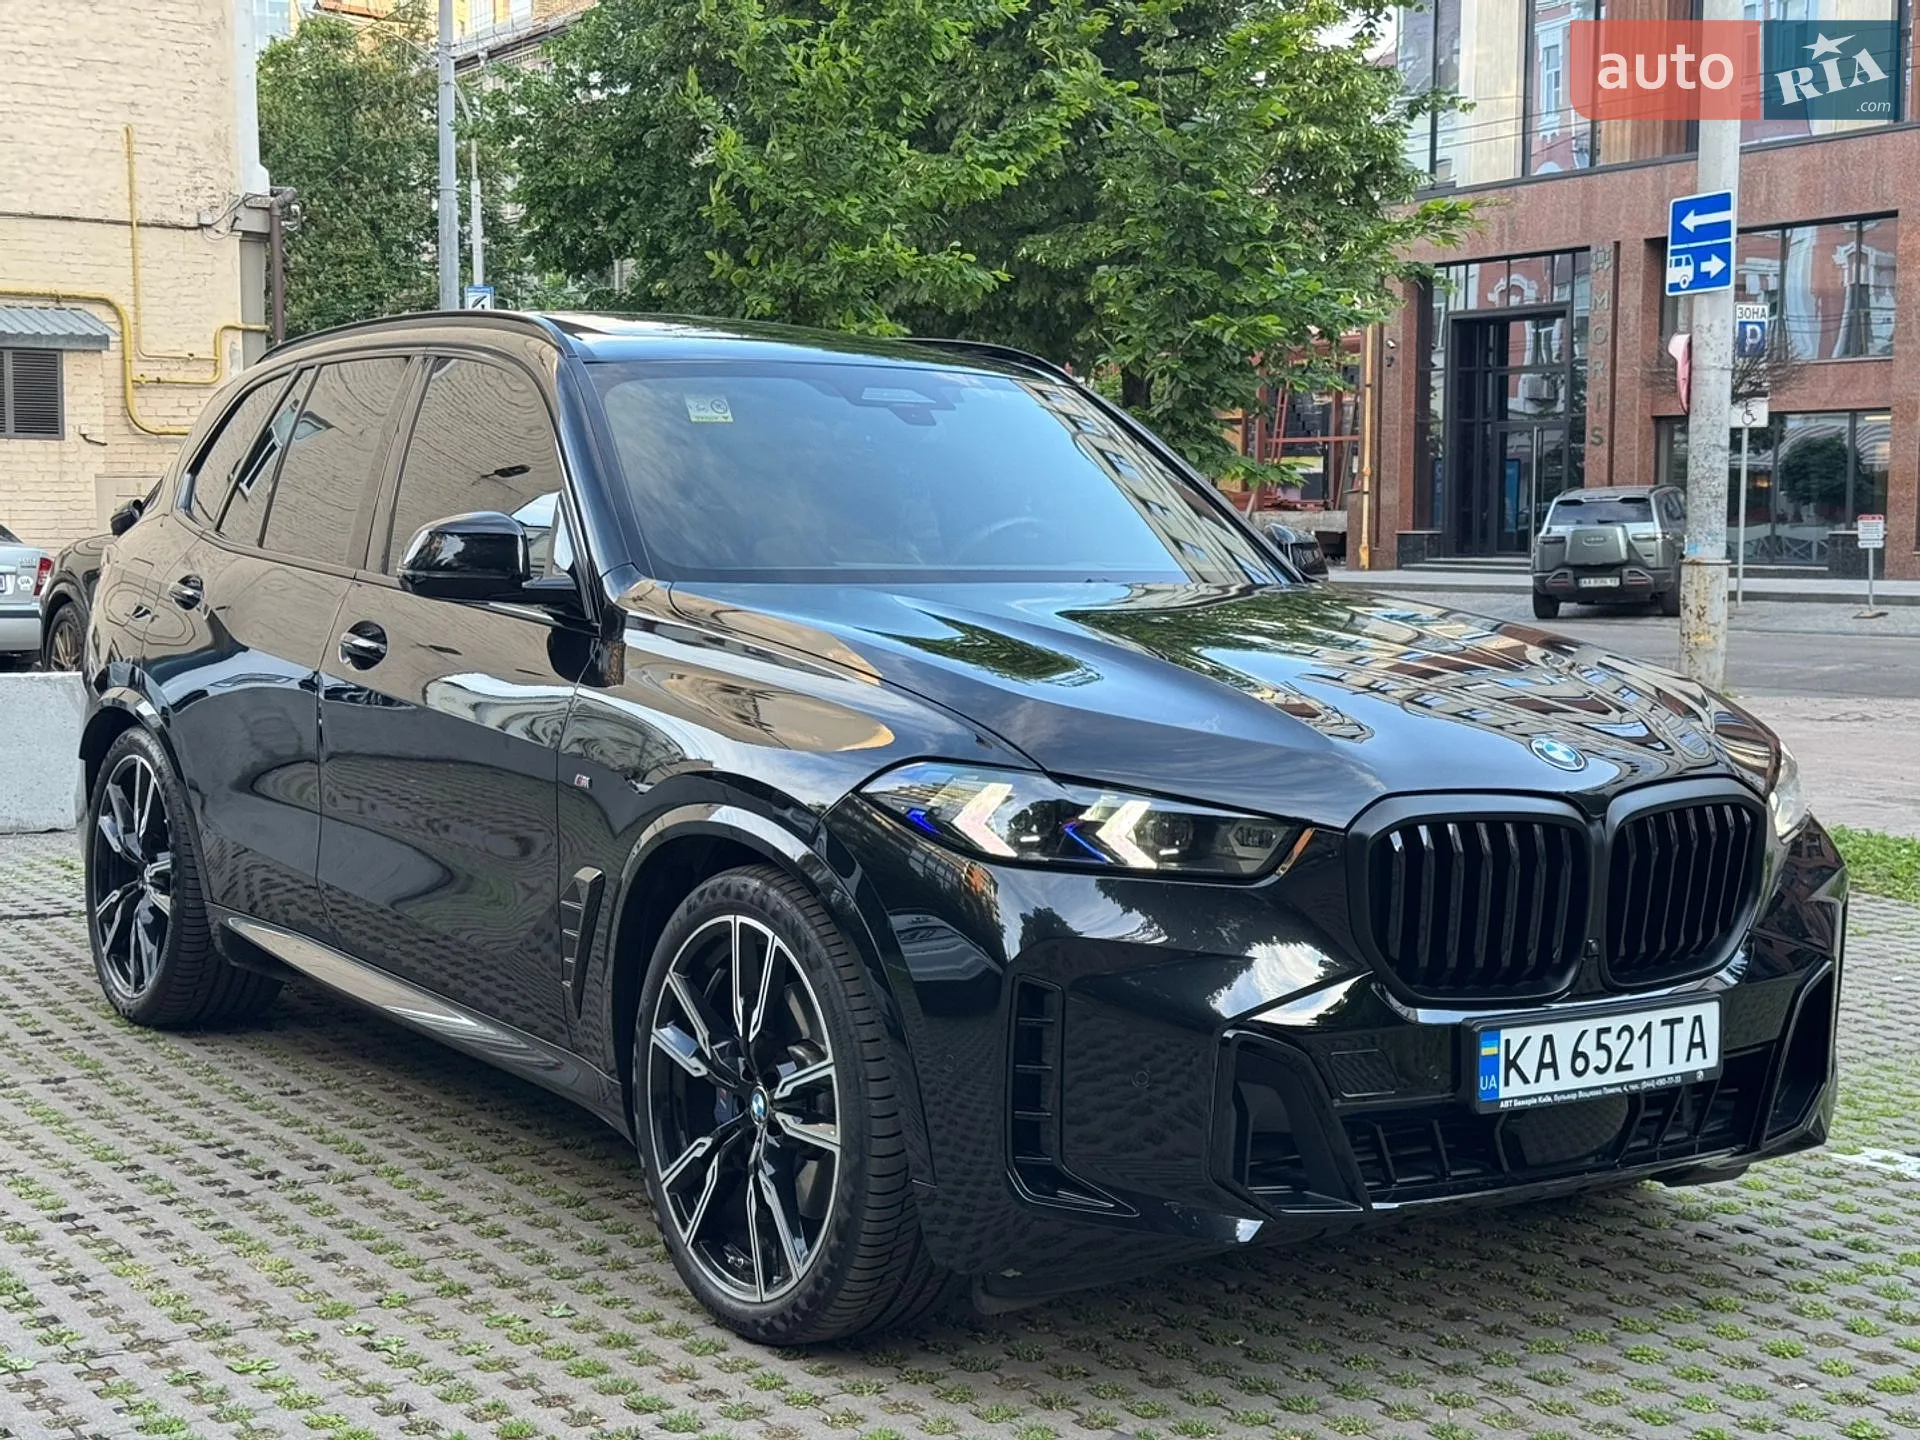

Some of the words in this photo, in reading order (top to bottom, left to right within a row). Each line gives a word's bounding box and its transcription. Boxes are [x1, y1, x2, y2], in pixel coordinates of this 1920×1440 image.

[1737, 307, 1767, 320] ЗОНА
[1503, 1034, 1560, 1087] KA
[1570, 1021, 1653, 1078] 6521
[1660, 1014, 1708, 1066] TA
[1480, 1074, 1498, 1091] UA
